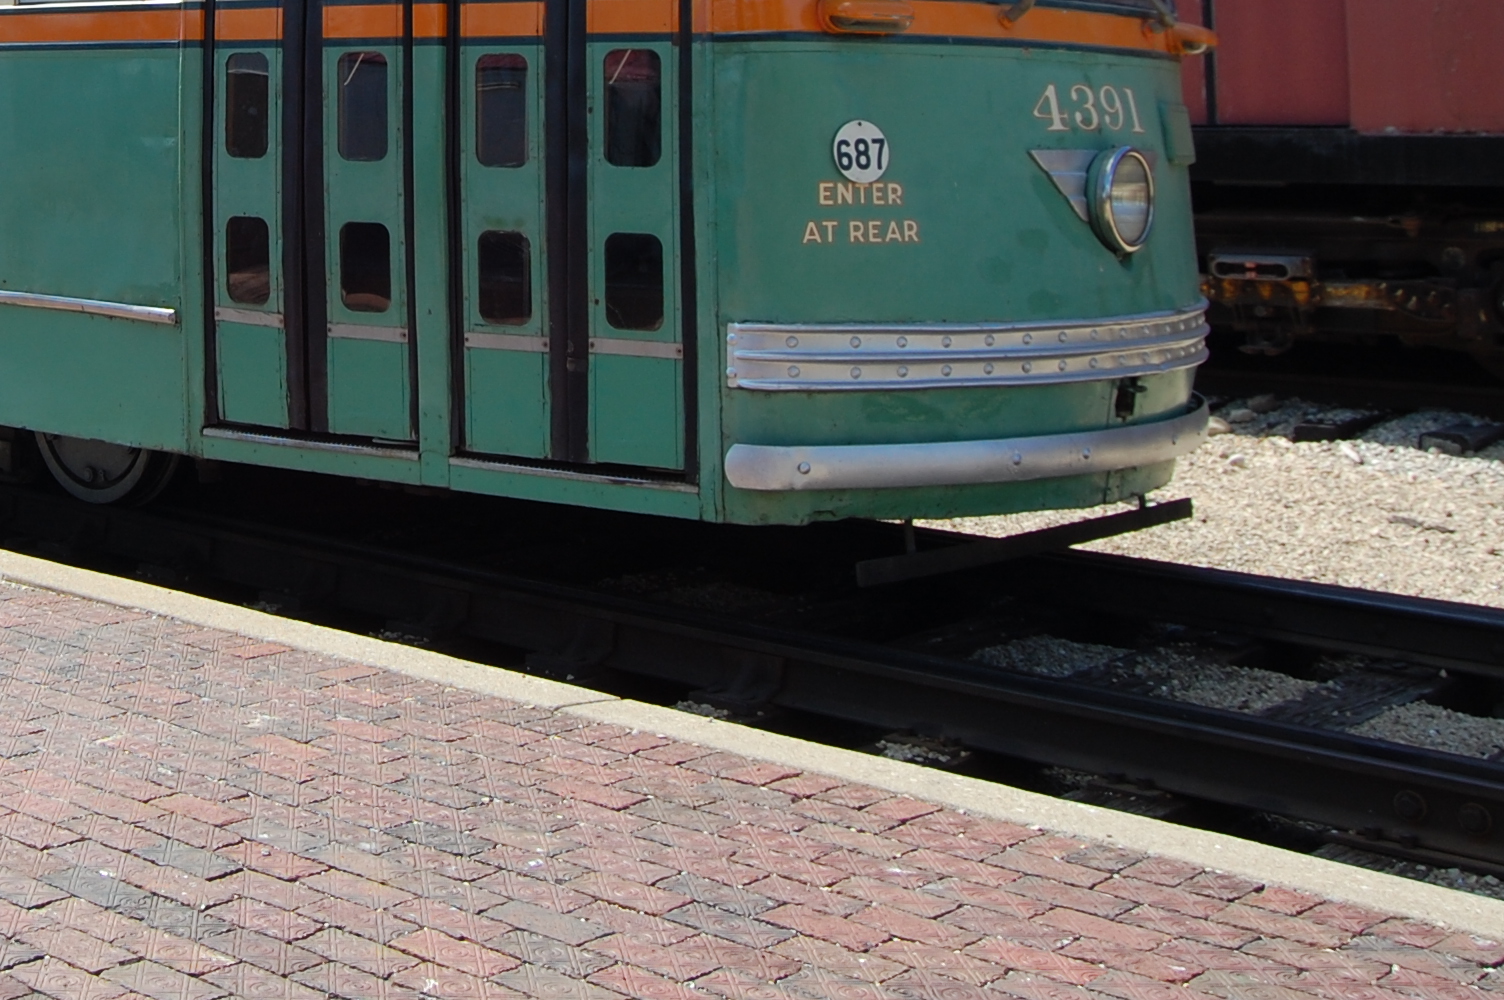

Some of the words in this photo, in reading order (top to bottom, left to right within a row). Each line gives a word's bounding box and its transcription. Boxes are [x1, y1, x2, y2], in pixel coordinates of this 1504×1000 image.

[1033, 84, 1145, 133] 4391
[836, 138, 885, 171] 687
[819, 182, 902, 205] ENTER
[803, 221, 838, 243] AT
[849, 220, 919, 243] REAR
